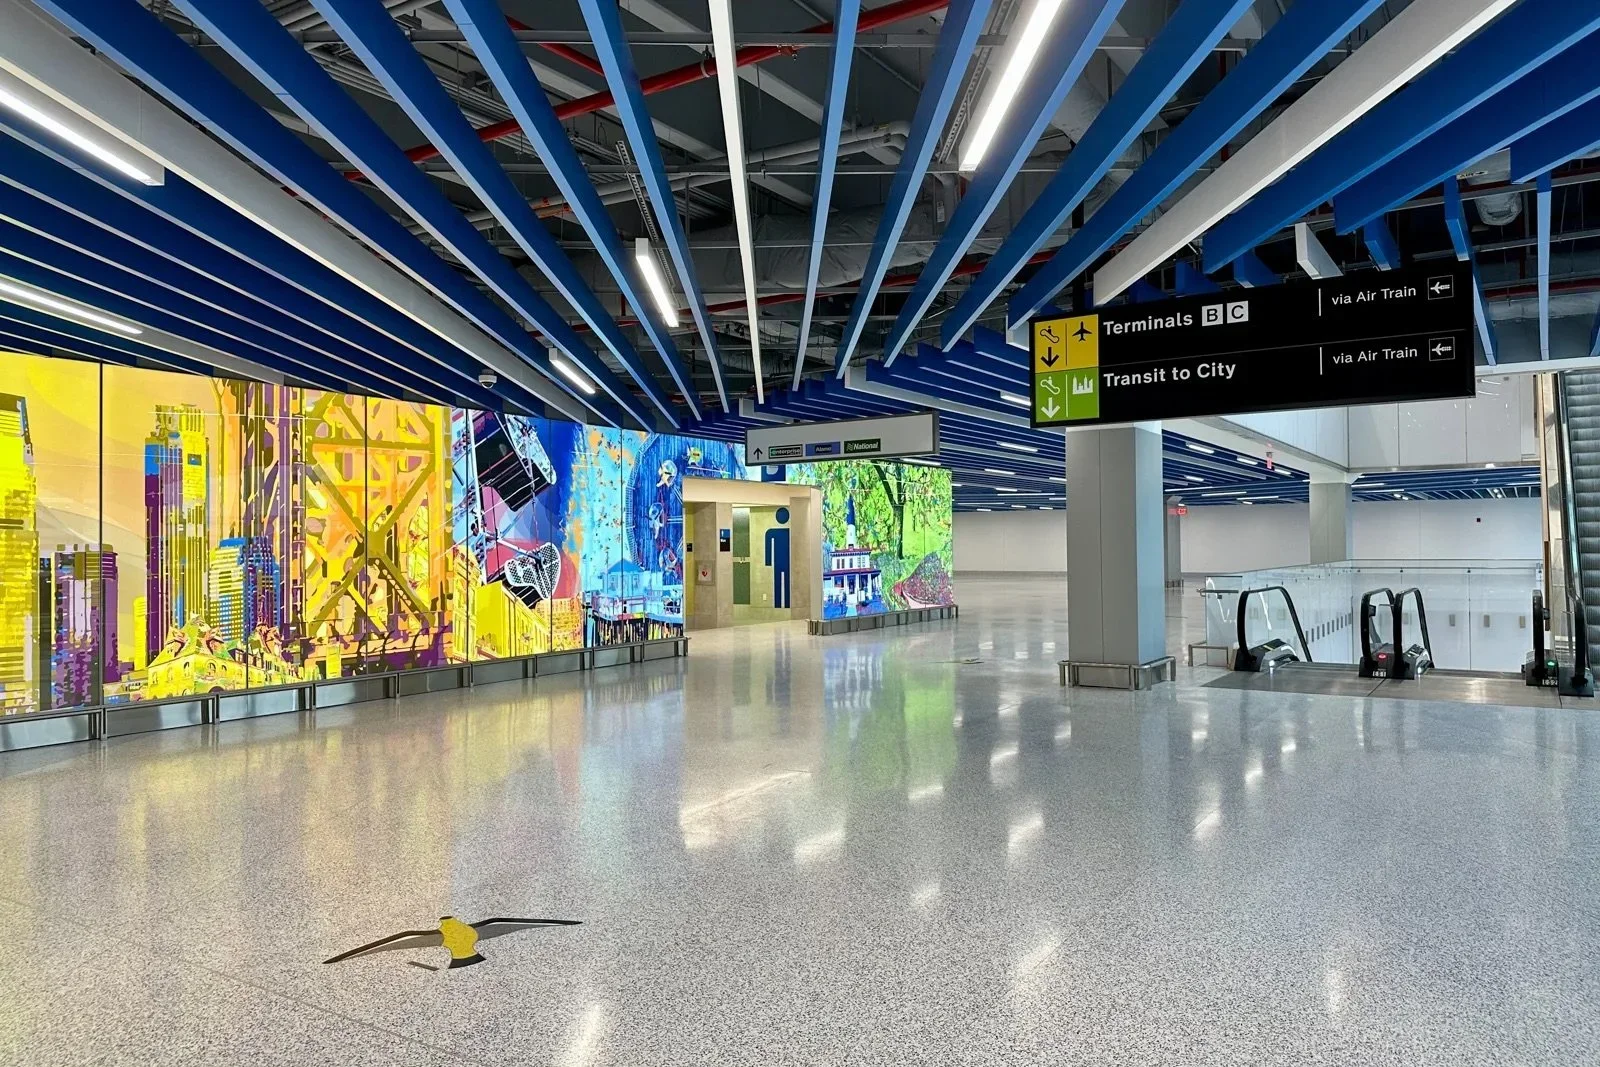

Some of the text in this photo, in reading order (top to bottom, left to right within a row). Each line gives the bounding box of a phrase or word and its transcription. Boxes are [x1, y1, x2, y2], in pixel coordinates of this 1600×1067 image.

[1331, 285, 1417, 306] via Air Train
[1103, 312, 1193, 336] Terminals
[1332, 346, 1418, 365] via Air Train
[1103, 361, 1236, 388] Transit to City
[853, 441, 879, 451] National
